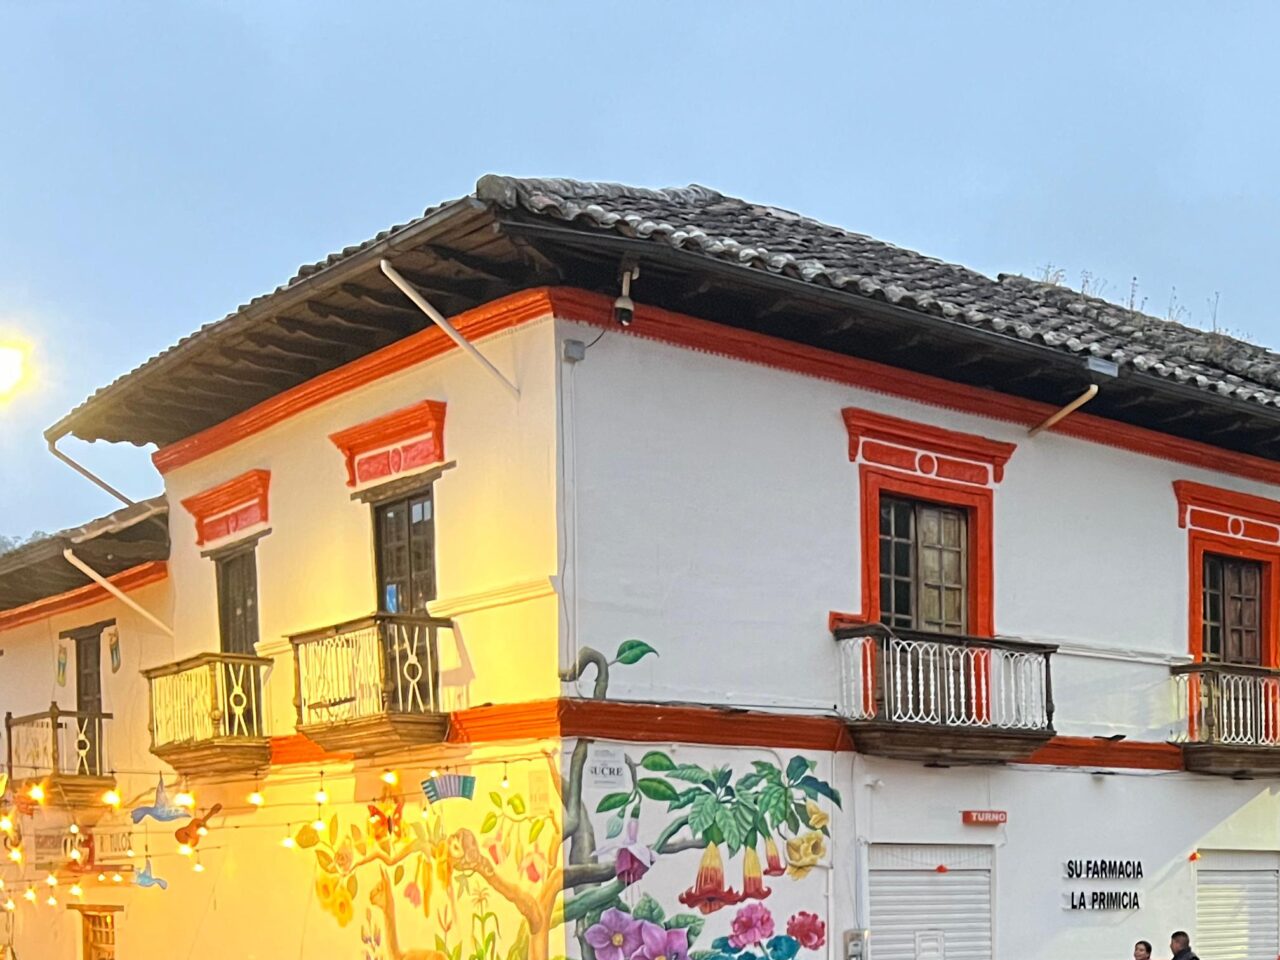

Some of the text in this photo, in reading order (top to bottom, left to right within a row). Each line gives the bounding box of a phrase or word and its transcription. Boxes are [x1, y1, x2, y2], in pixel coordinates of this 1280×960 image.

[971, 811, 1006, 822] TURNO
[1067, 859, 1143, 879] SU FARMACIA
[1071, 891, 1140, 910] LA PRIMICIA
